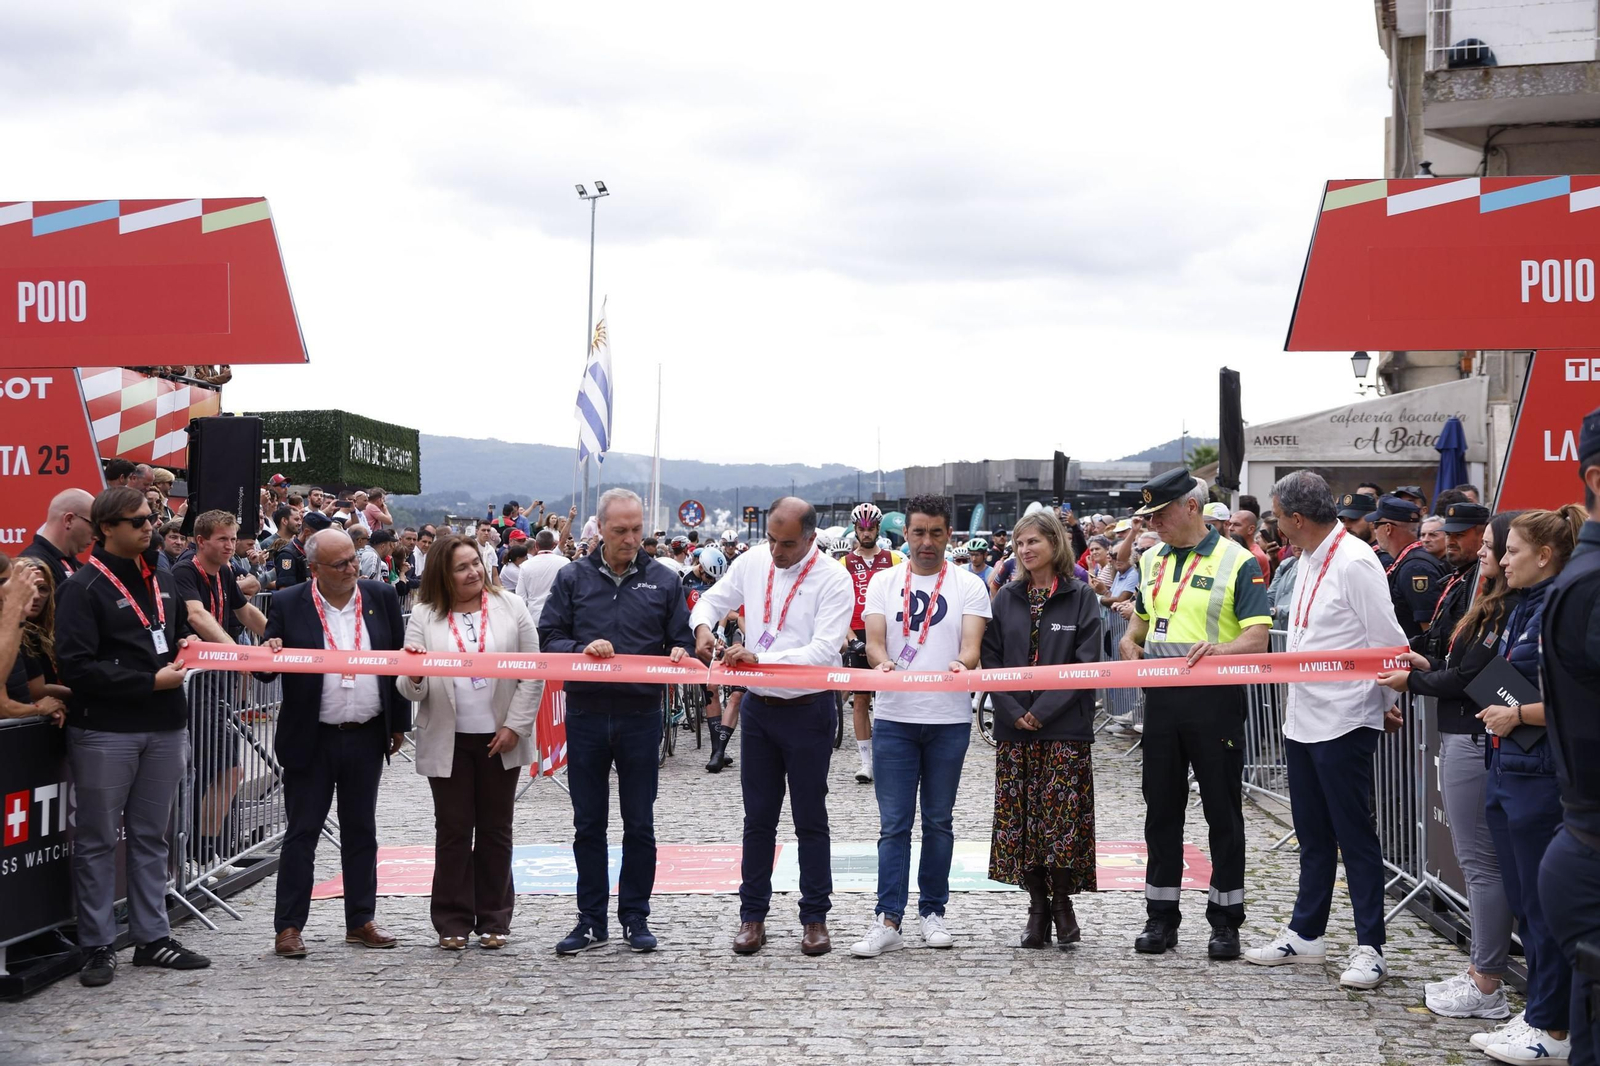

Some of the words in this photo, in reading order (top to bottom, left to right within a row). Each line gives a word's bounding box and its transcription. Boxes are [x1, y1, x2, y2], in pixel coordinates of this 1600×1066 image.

[1521, 258, 1595, 303] POIO
[18, 279, 86, 323] POIO
[0, 377, 53, 399] OT
[1330, 408, 1392, 428] cafetería
[1253, 435, 1299, 446] AMSTEL
[1354, 426, 1381, 454] A
[1544, 430, 1579, 461] LA
[38, 445, 70, 475] 25
[854, 563, 867, 605] Cofidis
[199, 651, 208, 660] LA
[209, 651, 238, 661] VUELTA
[273, 655, 284, 663] LA
[285, 655, 313, 663] VUELTA
[348, 656, 358, 664] LA
[359, 657, 388, 666] VUELTA
[423, 658, 432, 666] LA
[433, 659, 462, 667] VUELTA
[497, 660, 507, 668] LA
[508, 661, 537, 669] VUELTA
[572, 663, 581, 671] LA
[582, 663, 611, 671] VUELTA
[1300, 662, 1310, 672] LA
[1311, 661, 1342, 671] VUELTA
[1344, 660, 1355, 670] 25
[1383, 659, 1394, 669] LA
[1059, 671, 1068, 679] LA
[1070, 670, 1099, 678] VUELTA
[1101, 669, 1111, 677] 25
[1138, 668, 1147, 676] LA
[1149, 667, 1179, 676] VUELTA
[1181, 667, 1190, 675] 25
[1217, 666, 1228, 674] LA
[1229, 665, 1260, 674] VUELTA
[1261, 665, 1272, 673] 25
[827, 672, 850, 683] POIO
[982, 673, 991, 681] LA
[993, 672, 1021, 681] VUELTA
[1497, 687, 1507, 698] LA
